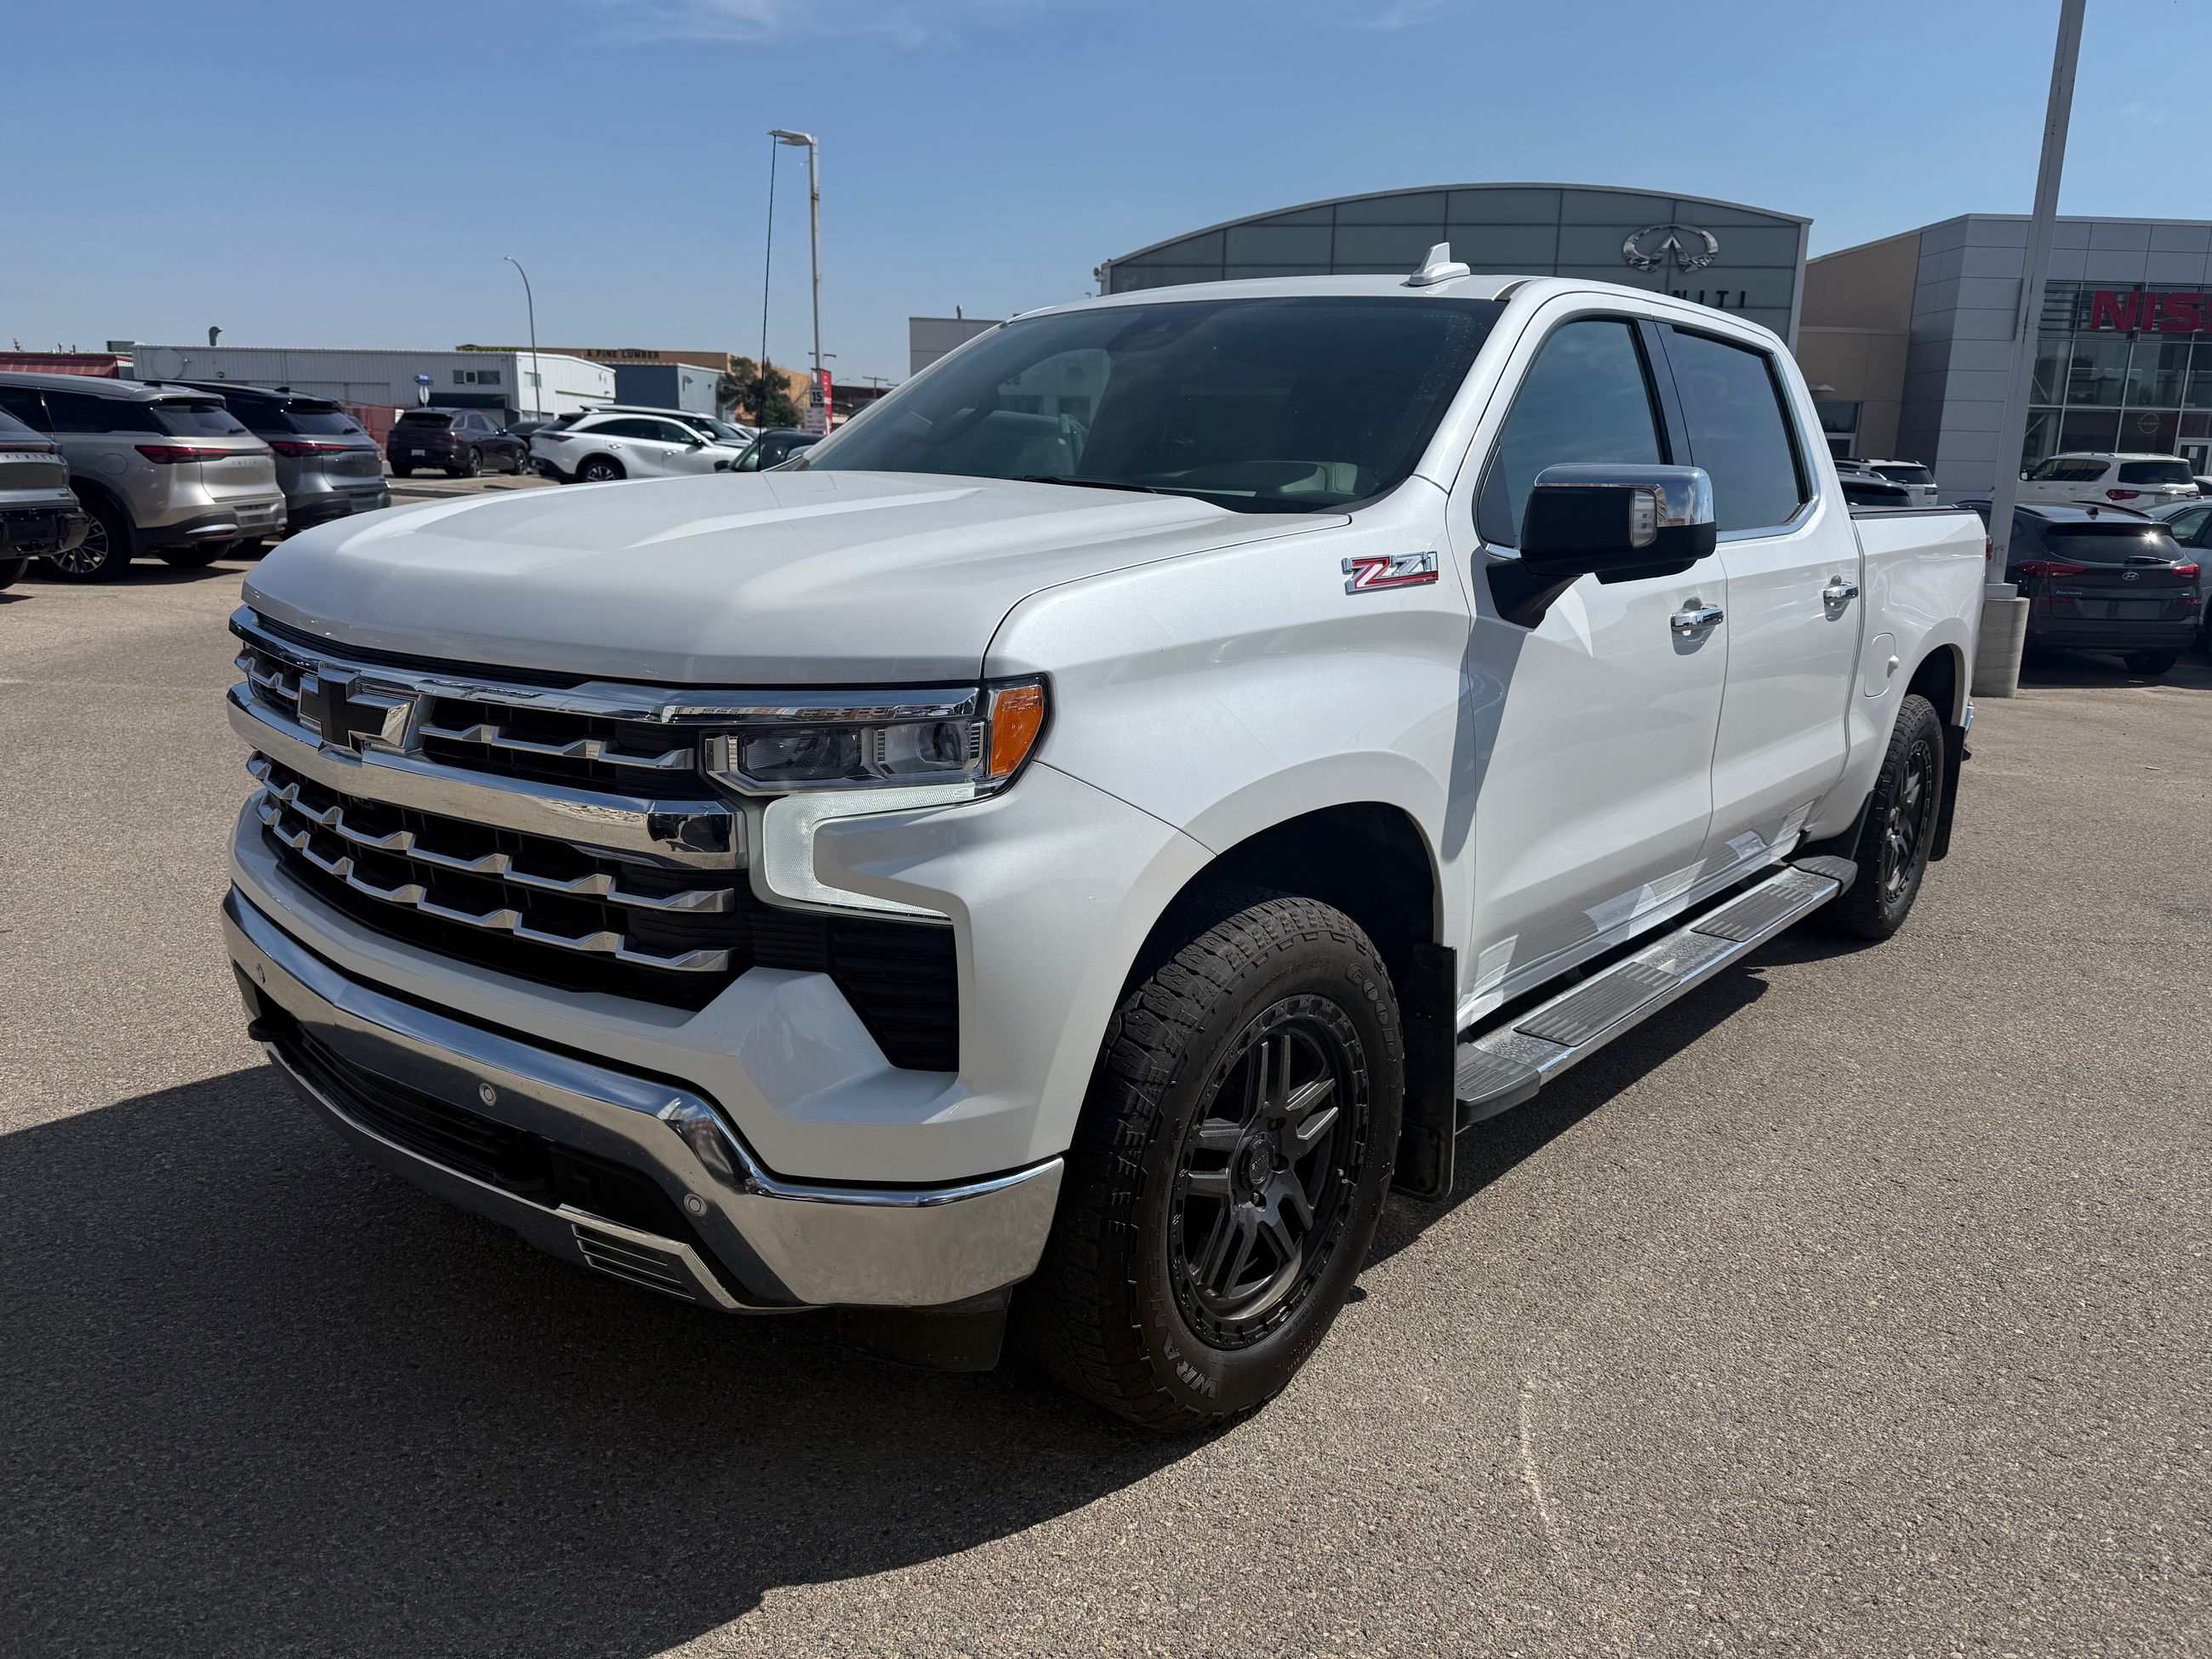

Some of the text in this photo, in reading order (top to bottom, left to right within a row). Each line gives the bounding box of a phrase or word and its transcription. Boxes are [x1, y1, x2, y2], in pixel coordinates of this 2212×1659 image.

[2090, 290, 2212, 334] NIS
[621, 349, 660, 361] LUMBER
[811, 391, 824, 403] 15
[1342, 550, 1440, 596] Z71
[1146, 1116, 1218, 1400] WRANGLER
